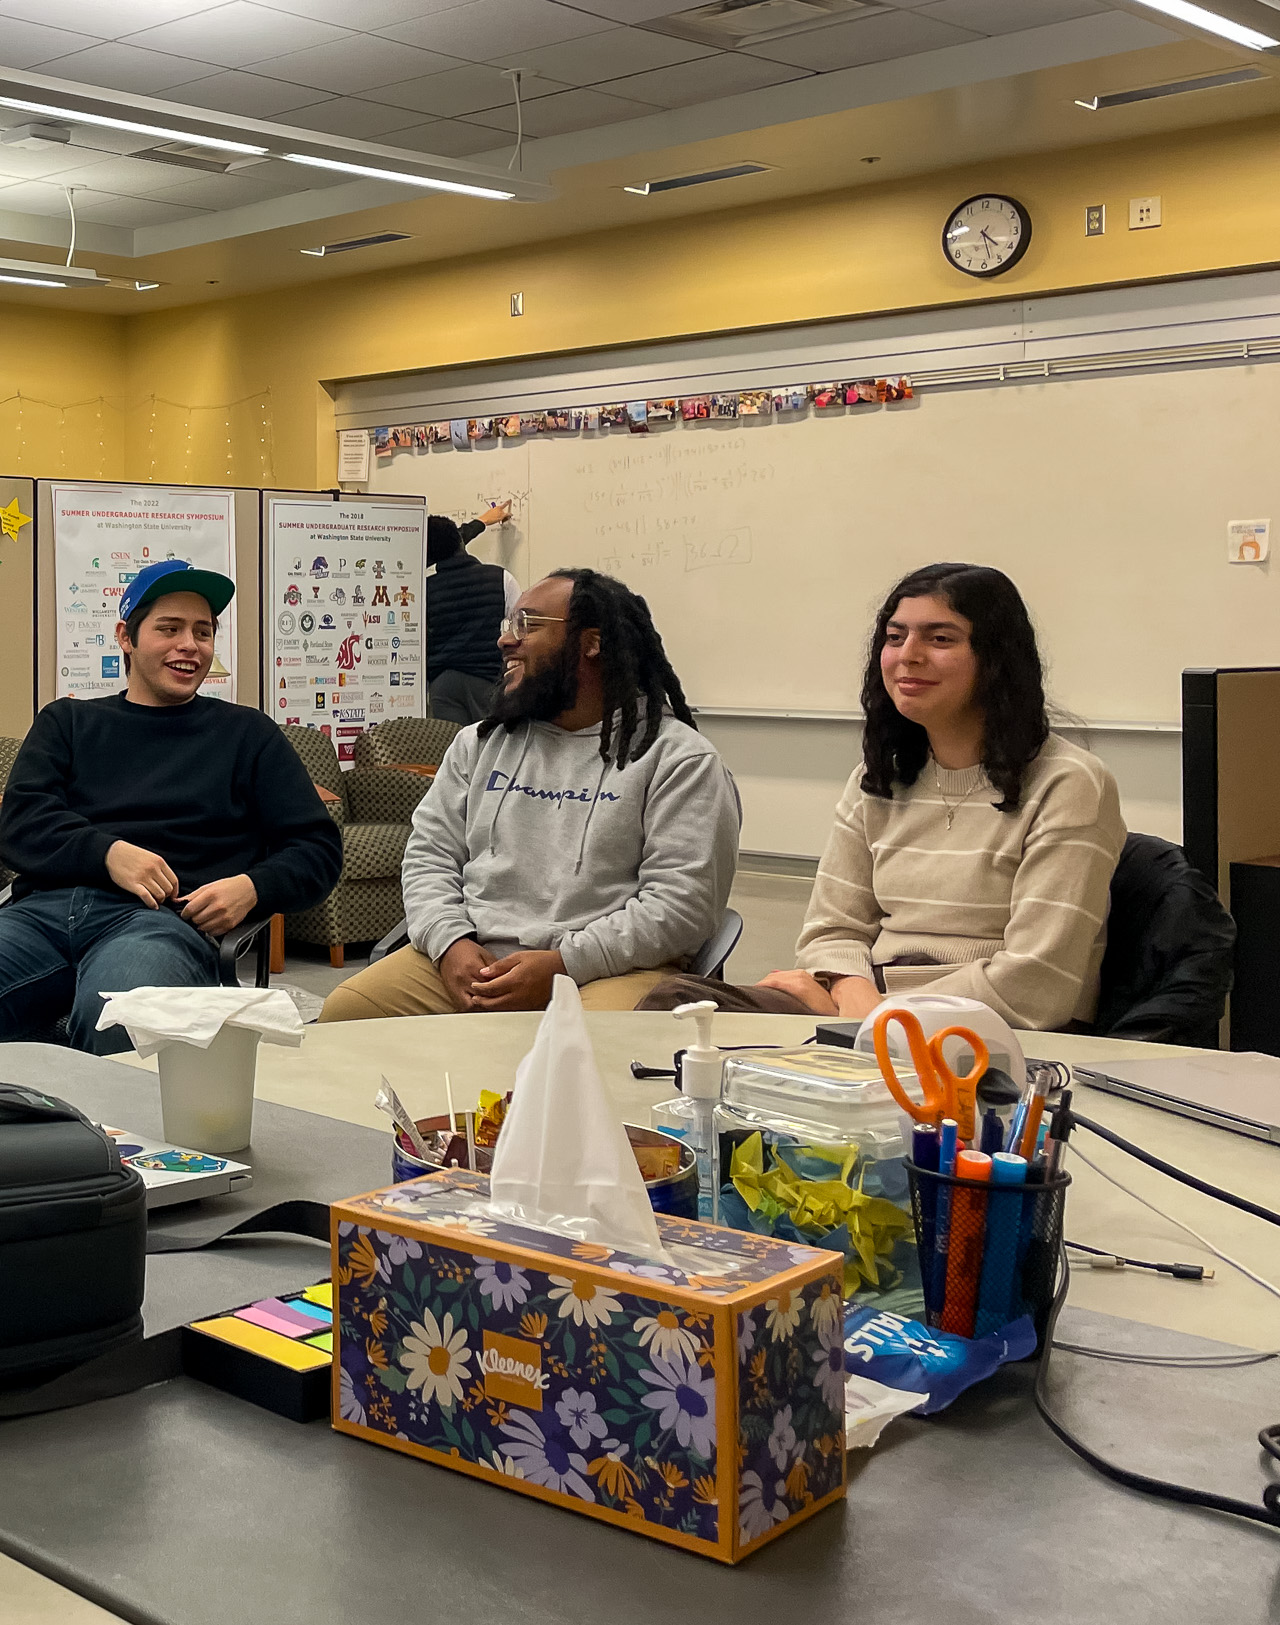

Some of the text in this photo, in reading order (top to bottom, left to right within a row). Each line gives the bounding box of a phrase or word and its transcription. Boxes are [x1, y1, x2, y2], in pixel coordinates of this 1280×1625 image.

[981, 200, 990, 209] 12
[966, 207, 973, 216] 11
[1010, 211, 1016, 219] 2
[954, 220, 963, 228] 10
[1013, 226, 1019, 235] 3
[1007, 241, 1014, 250] 4
[954, 249, 961, 259] 8
[996, 254, 1003, 263] 5
[967, 257, 973, 267] 7
[980, 259, 988, 270] 6
[61, 509, 224, 521] SUMMER UNDERGRADUATE RESEARCH SYMPOSIUM
[104, 522, 143, 530] Washington
[143, 522, 160, 530] State
[160, 523, 192, 532] University
[305, 523, 356, 531] UNDERGRADUATE
[317, 533, 349, 541] Washington
[485, 769, 621, 810] Champin
[475, 1348, 551, 1390] Kleenex
